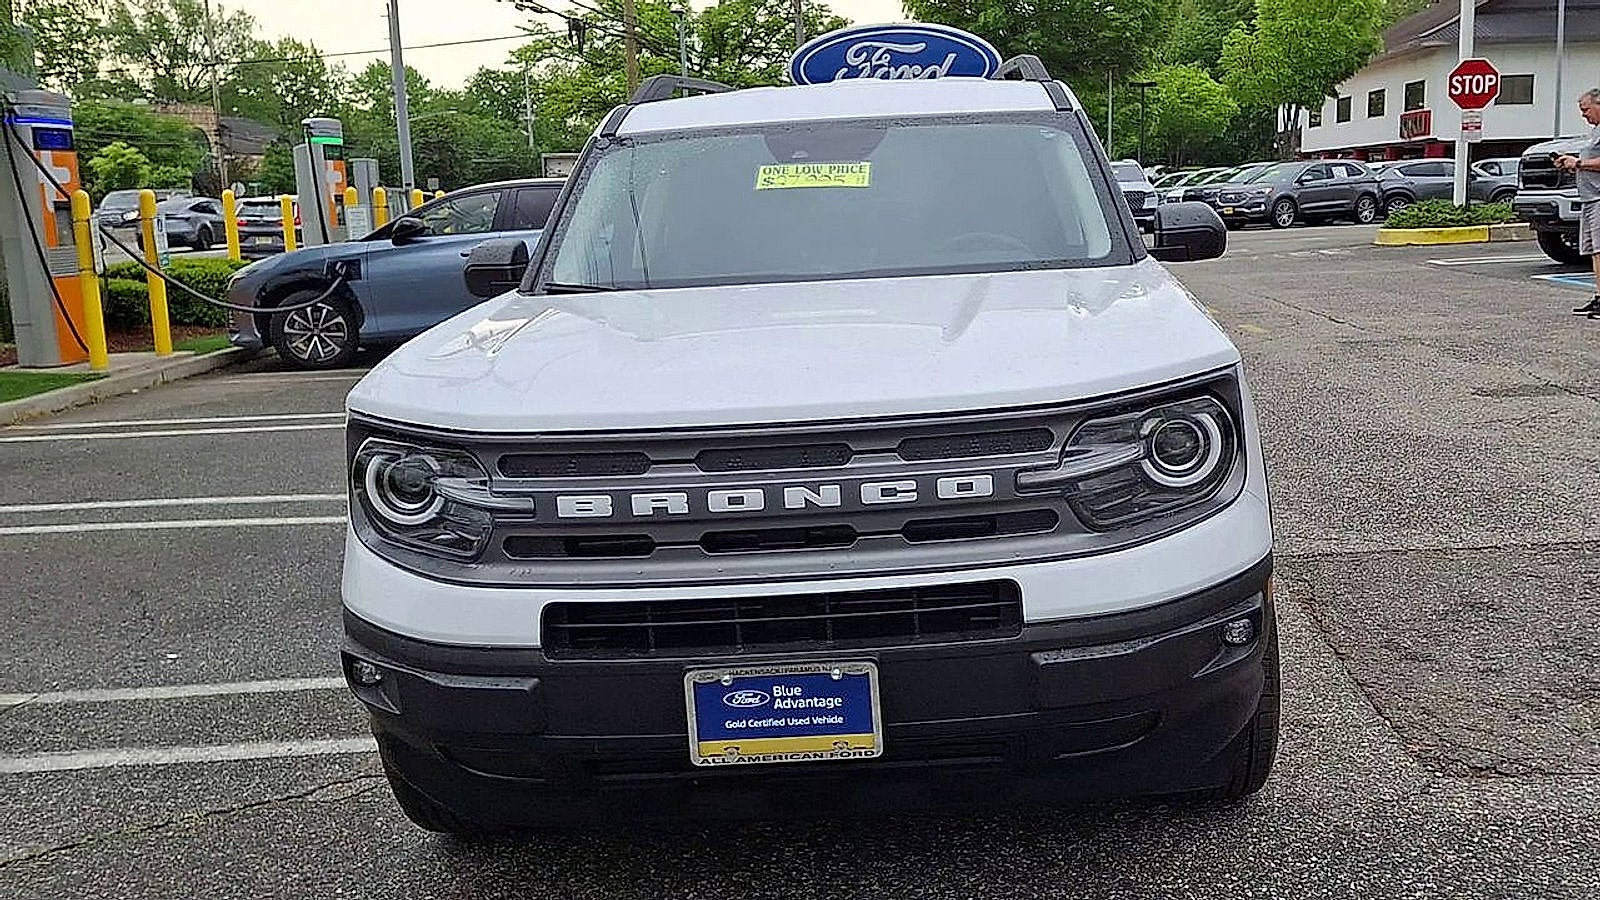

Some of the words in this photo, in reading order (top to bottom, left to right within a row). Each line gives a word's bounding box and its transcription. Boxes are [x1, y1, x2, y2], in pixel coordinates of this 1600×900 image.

[835, 41, 957, 80] Ford
[1451, 74, 1496, 95] STOP
[762, 165, 789, 175] ONE
[796, 165, 823, 175] LOW
[829, 164, 867, 174] PRICE
[556, 474, 995, 518] BRONCO
[732, 692, 761, 704] Ford
[773, 685, 802, 697] Blue
[773, 696, 842, 709] Advantage
[725, 719, 747, 729] Gold
[748, 718, 785, 728] Certified
[787, 717, 811, 727] Used
[812, 715, 844, 725] Vehicle
[700, 757, 731, 765] ALL
[733, 752, 823, 763] AMERICAN
[829, 750, 875, 759] FORD
